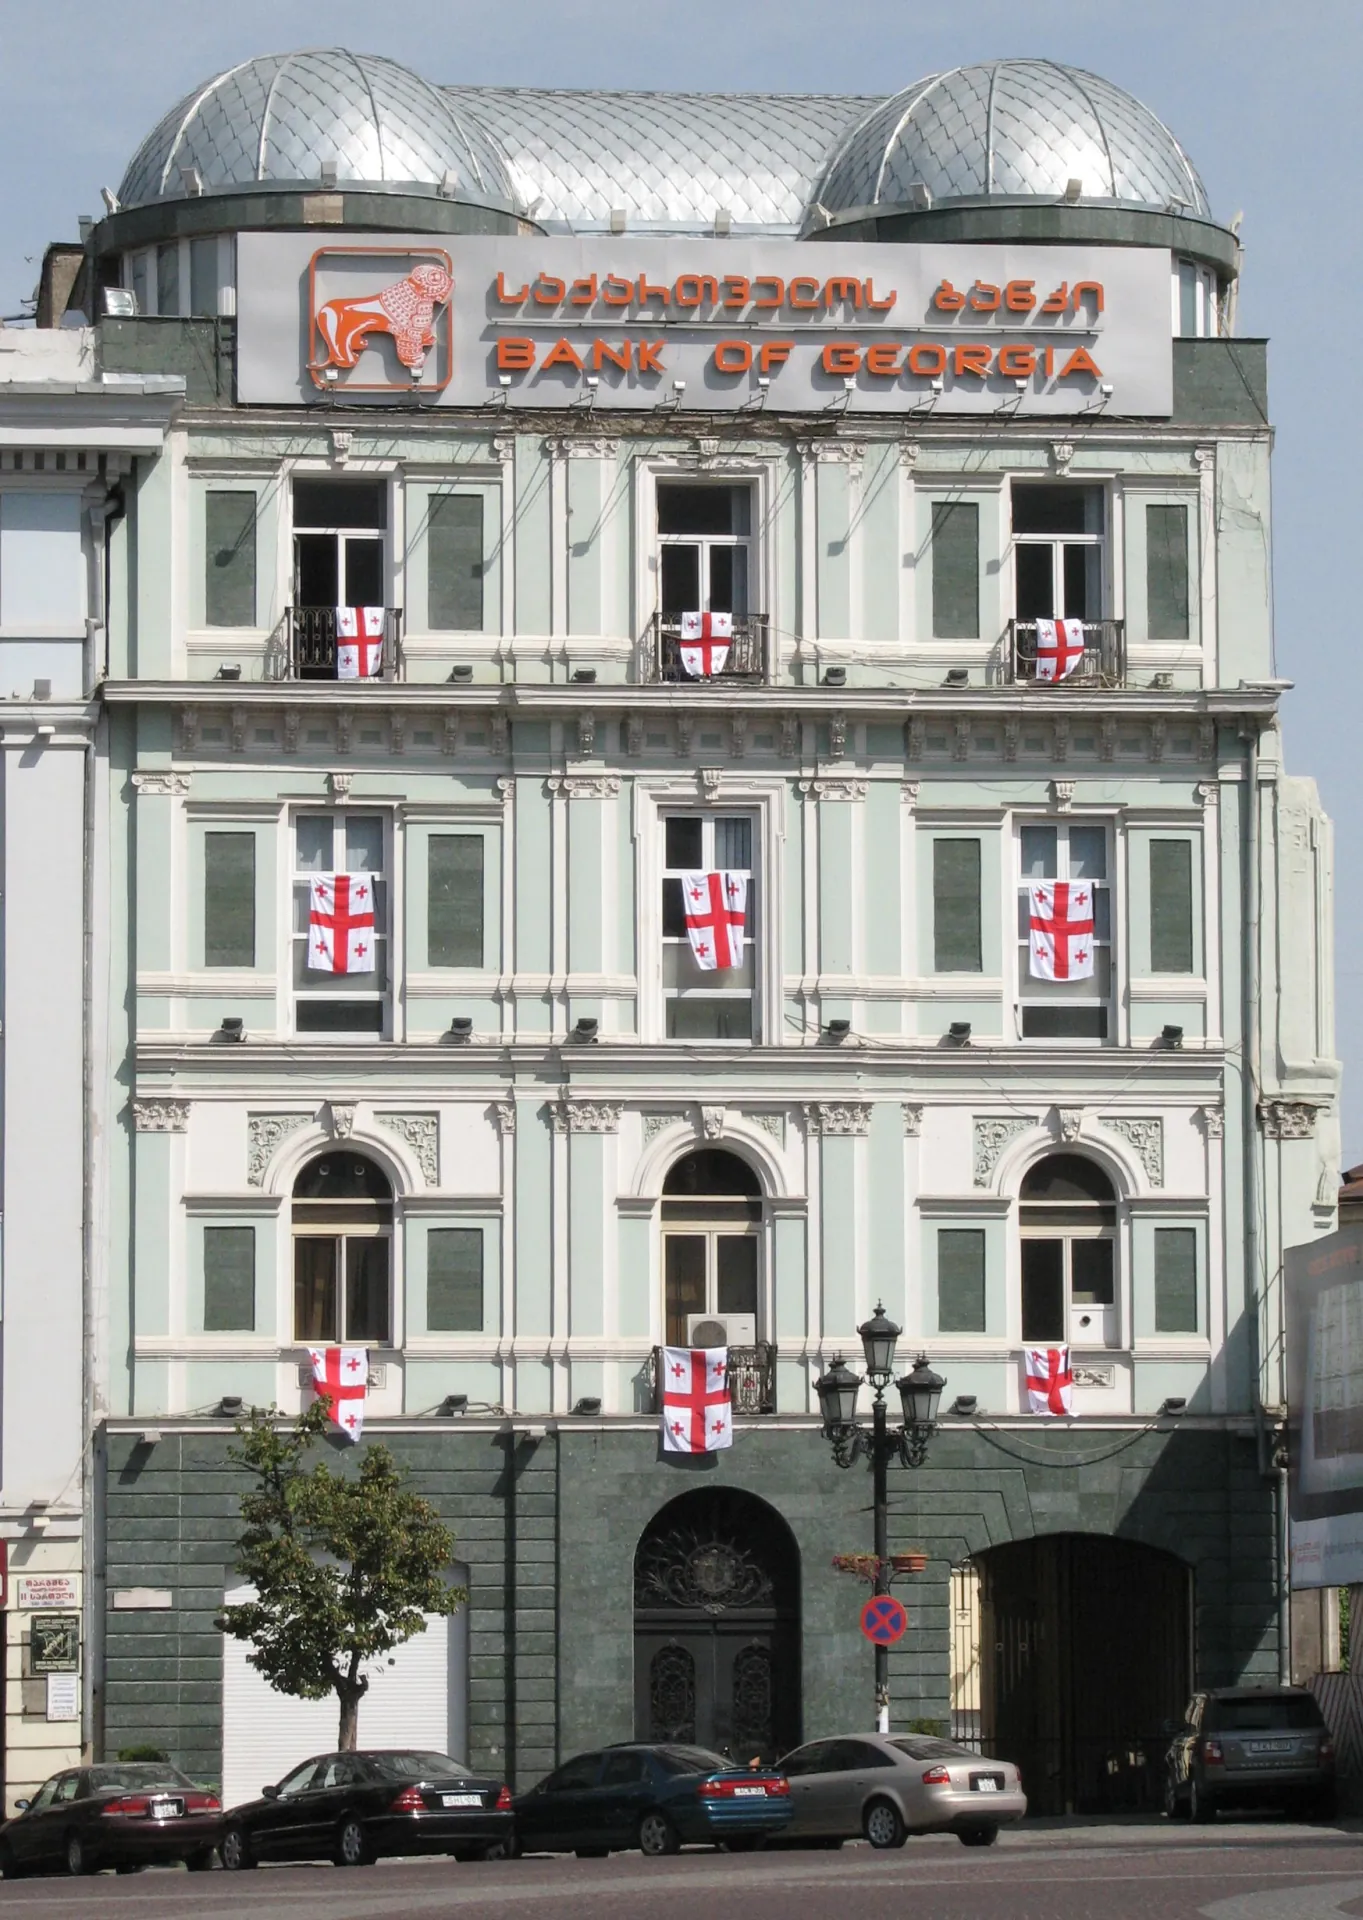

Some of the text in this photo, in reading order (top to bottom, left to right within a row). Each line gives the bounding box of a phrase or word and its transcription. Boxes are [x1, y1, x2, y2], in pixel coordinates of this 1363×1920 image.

[496, 271, 1104, 312] საქართველოს ბანკი
[497, 337, 1104, 379] BANK OF GEORGIA
